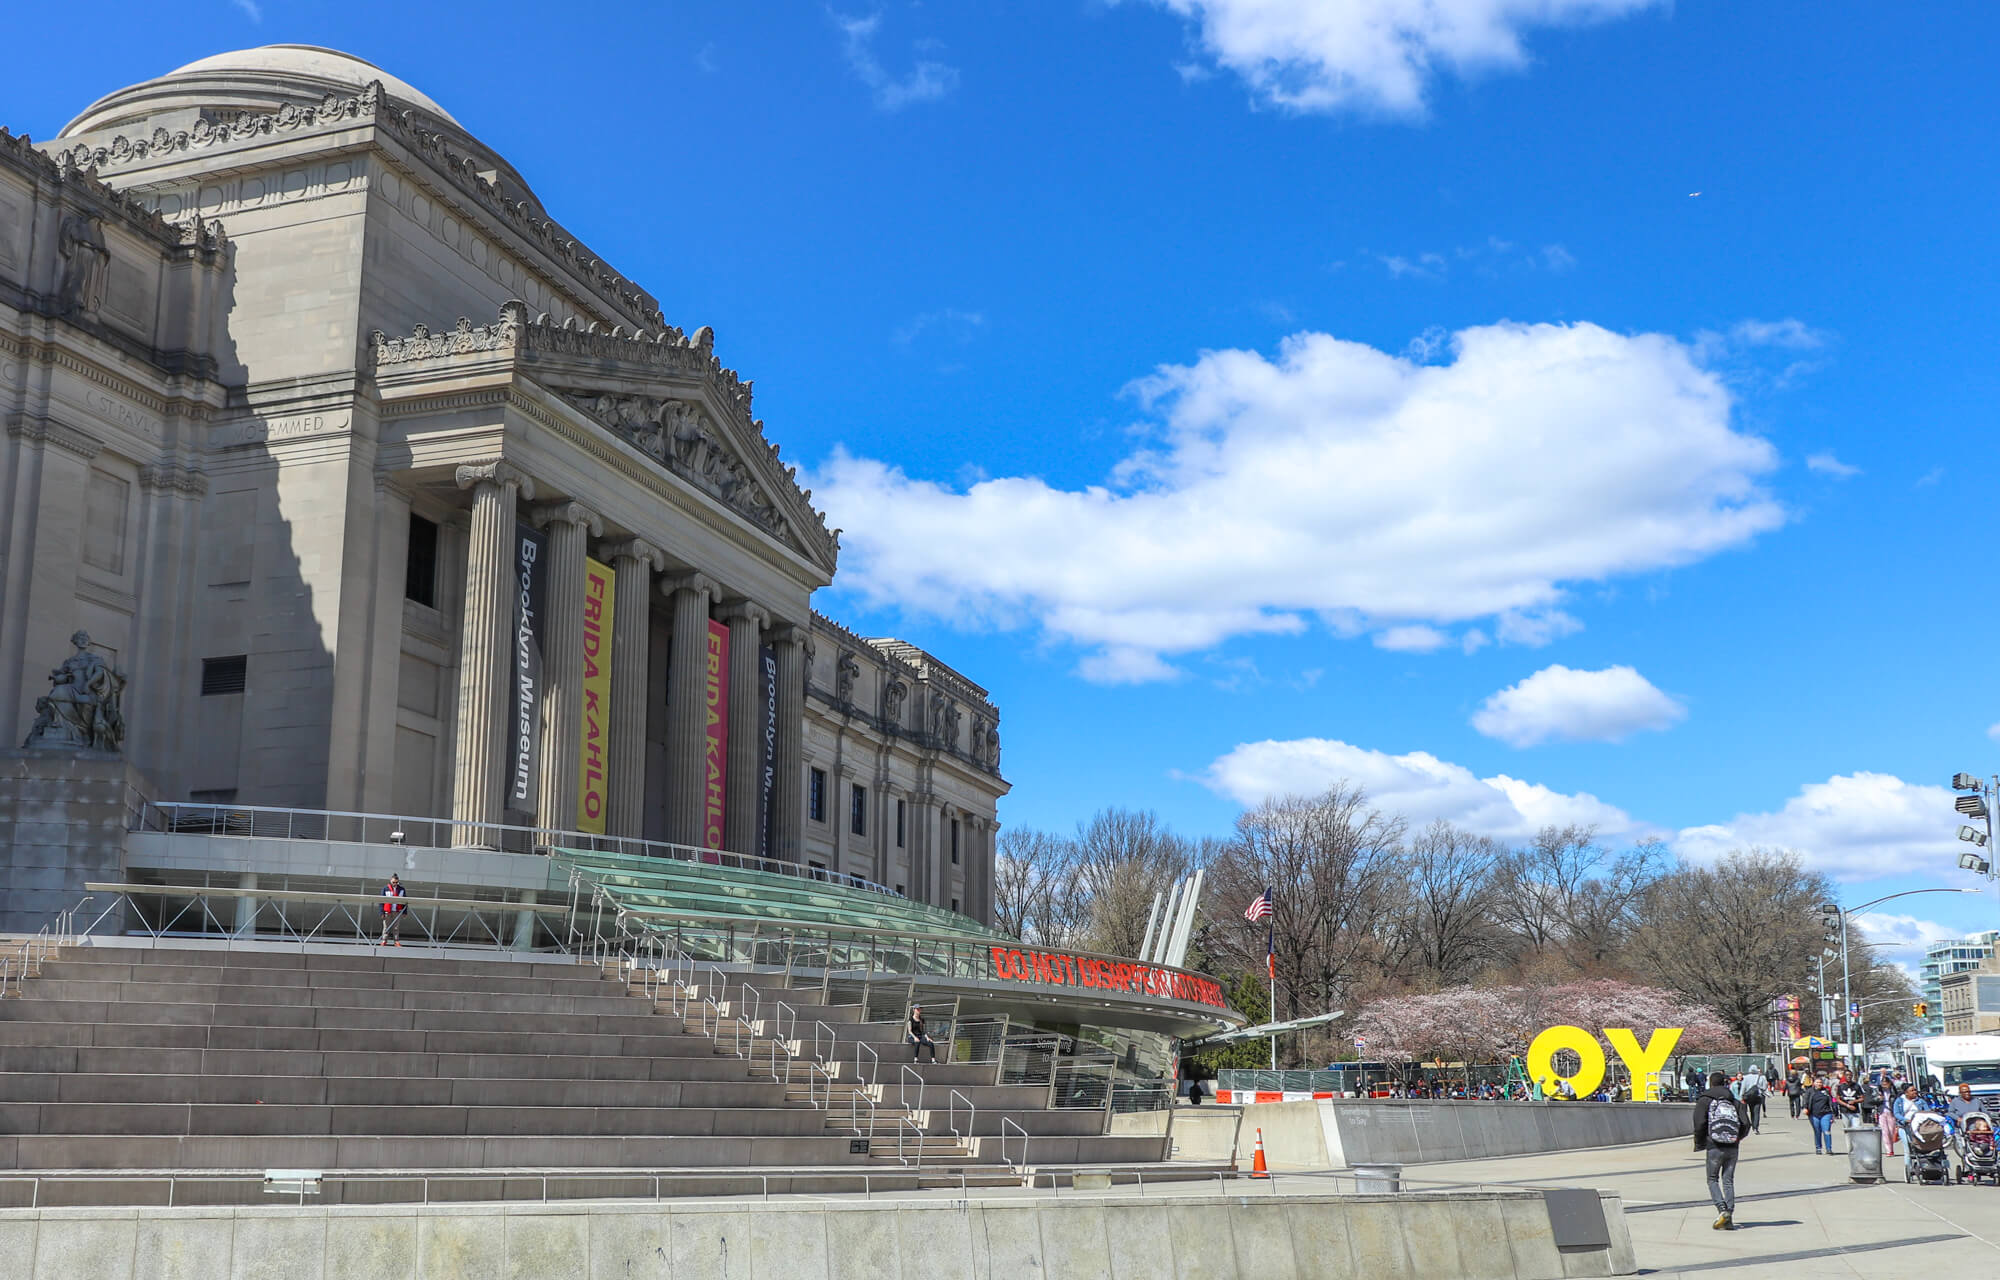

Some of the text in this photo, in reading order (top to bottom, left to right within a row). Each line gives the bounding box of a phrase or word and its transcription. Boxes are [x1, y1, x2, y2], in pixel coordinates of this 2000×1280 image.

[233, 416, 325, 441] MOHAMMED
[516, 537, 538, 800] Brooklyn Museum
[584, 572, 606, 819] FRIDA KAHLO
[765, 656, 776, 761] Brooklyn
[706, 632, 722, 850] FRIDA KAHLO
[991, 947, 1030, 980] DO
[1029, 950, 1076, 985] NOT
[1075, 956, 1174, 998] DISAPPEAR
[1527, 1025, 1684, 1102] OY
